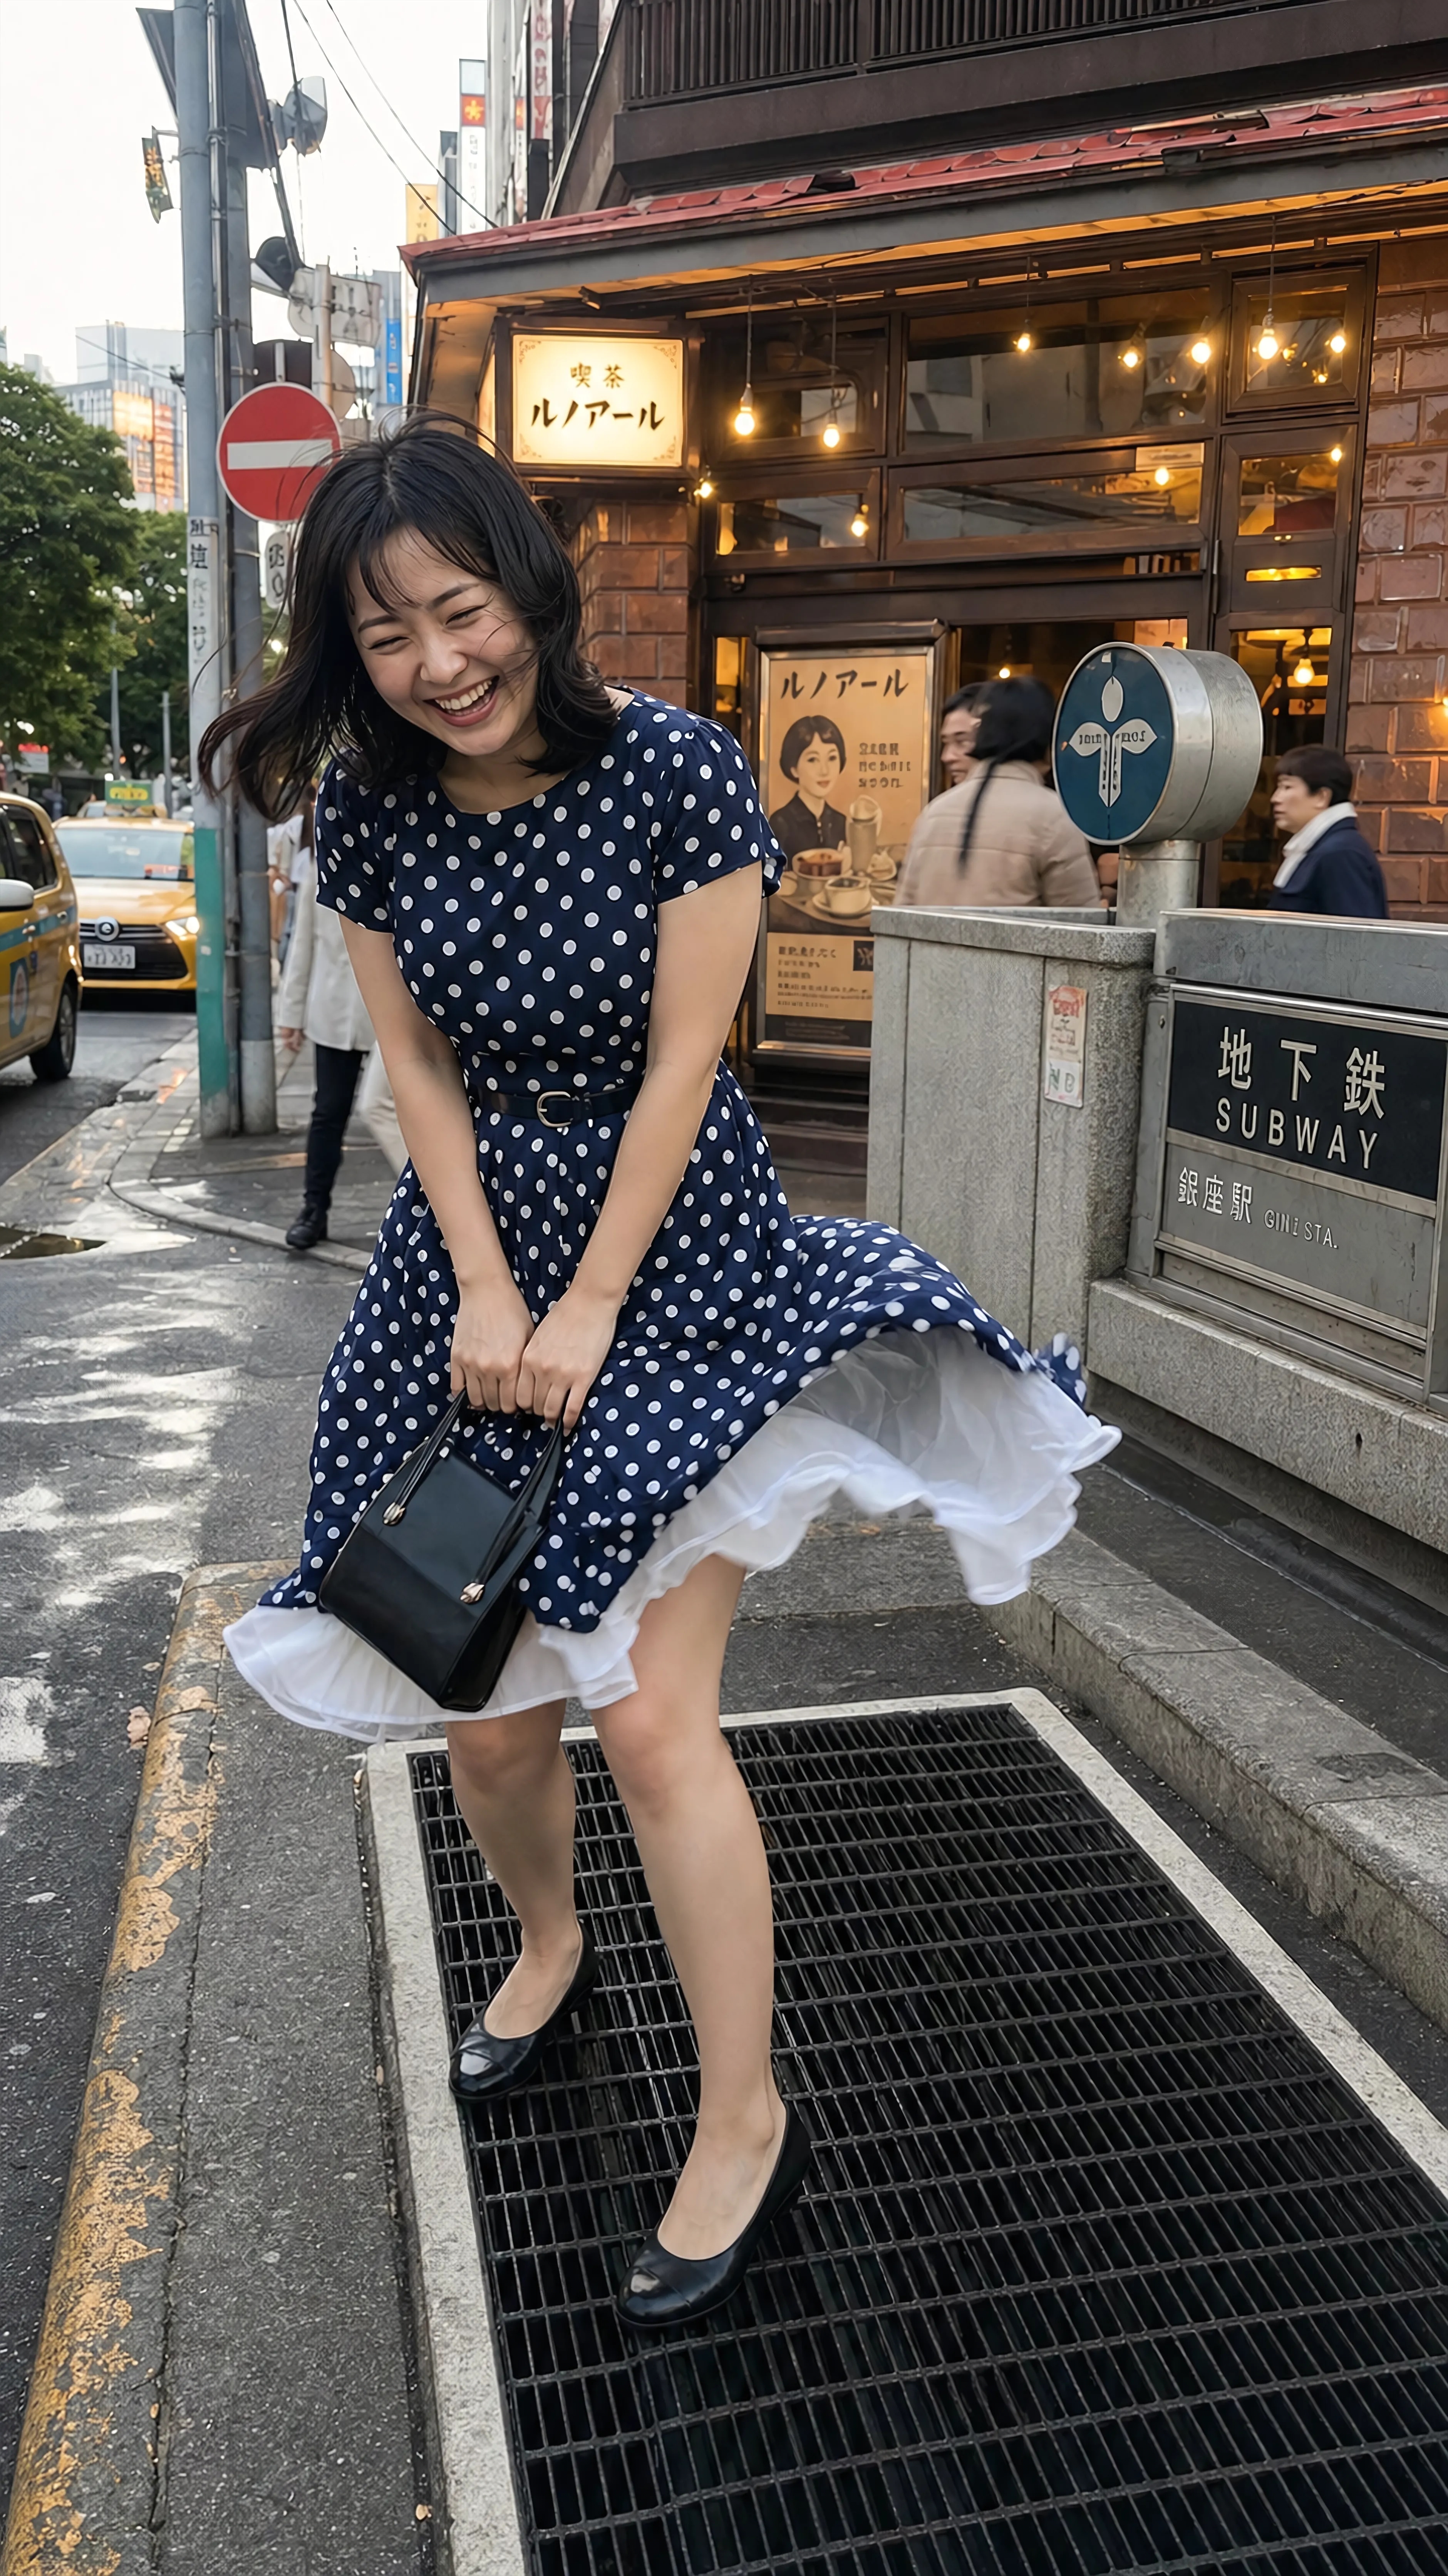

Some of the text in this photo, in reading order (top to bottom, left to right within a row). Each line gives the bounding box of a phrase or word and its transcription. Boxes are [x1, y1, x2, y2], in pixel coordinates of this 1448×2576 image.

[570, 363, 624, 388] 喫茶
[531, 398, 665, 431] ルノアール
[781, 669, 908, 699] ルノアール
[1218, 1026, 1385, 1119] 地下鉄
[1216, 1098, 1378, 1169] SUBWAY
[1178, 1167, 1252, 1223] 銀座駅
[1304, 1222, 1337, 1248] STA.
